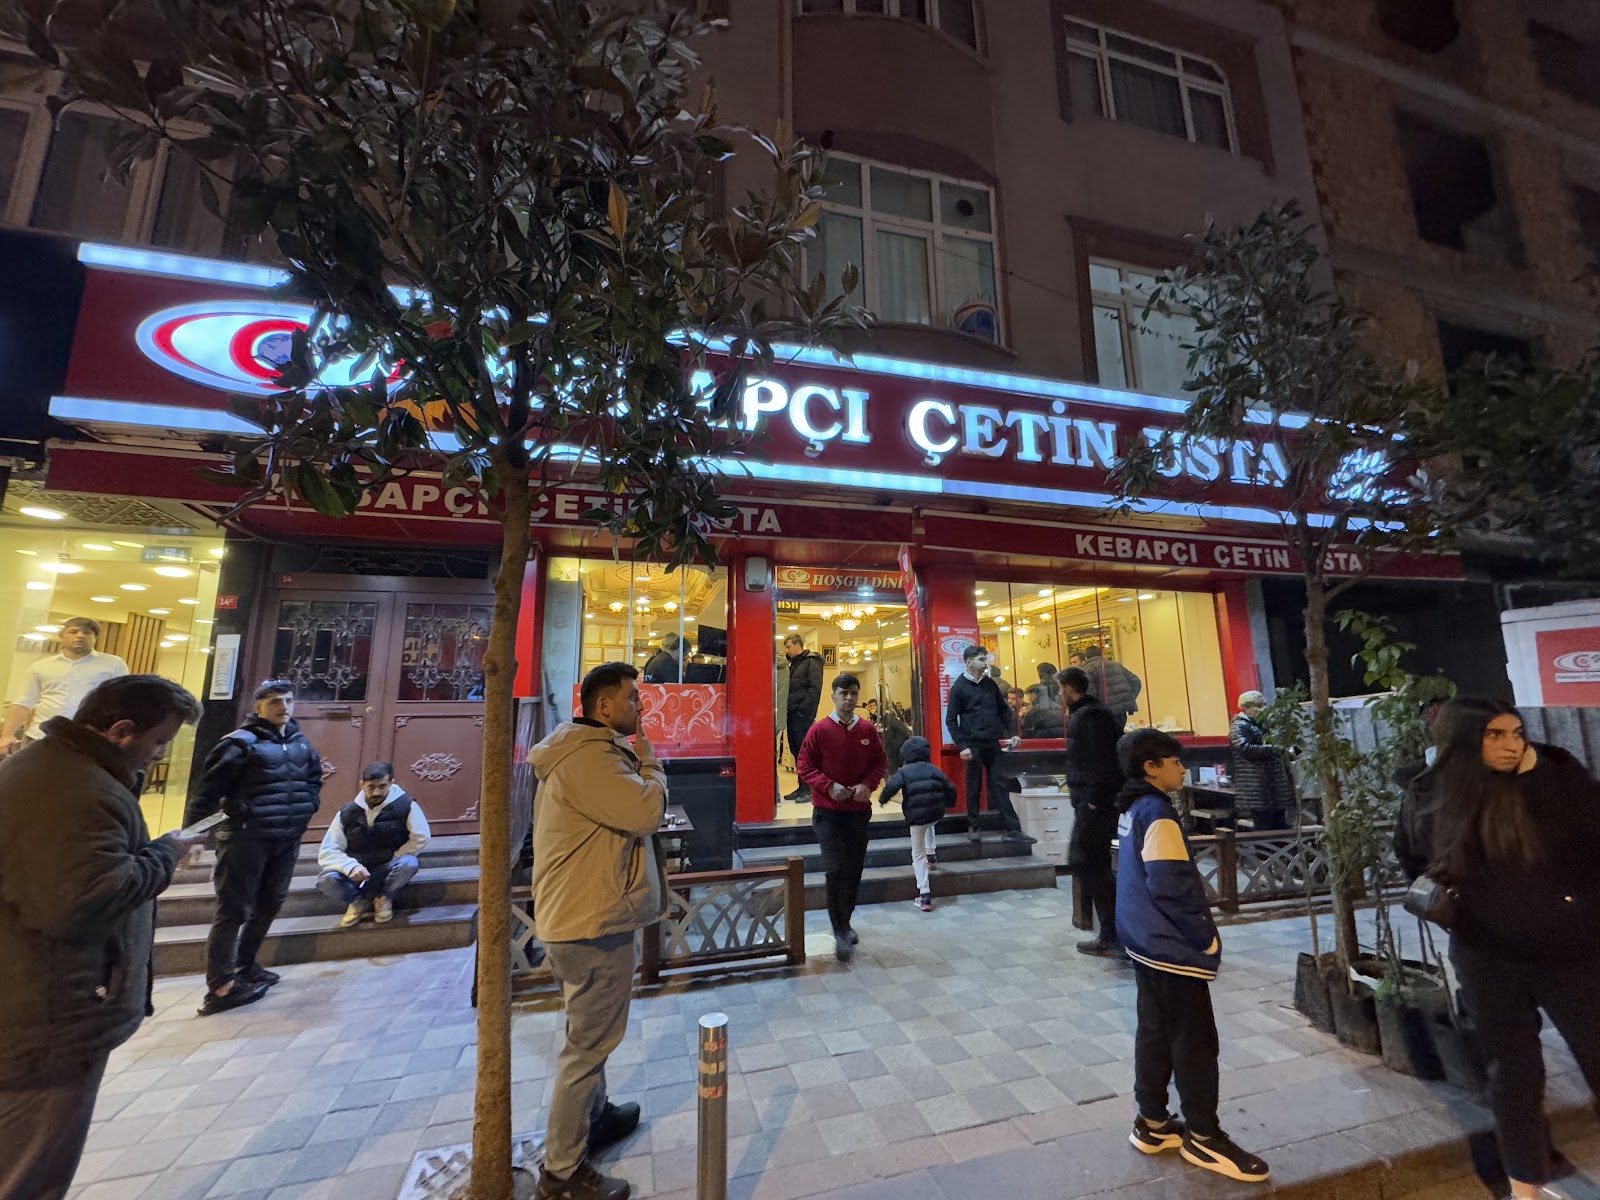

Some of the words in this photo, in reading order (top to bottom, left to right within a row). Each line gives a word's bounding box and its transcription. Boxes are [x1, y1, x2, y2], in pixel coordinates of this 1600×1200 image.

[908, 400, 1117, 469] ÇETİN
[1143, 427, 1288, 487] USTA
[265, 473, 489, 517] KAPÇI
[683, 504, 782, 533] STA
[1075, 533, 1198, 566] KEBAPÇI
[1316, 551, 1362, 572] STA
[812, 573, 903, 589] HOŞGELDİNİ
